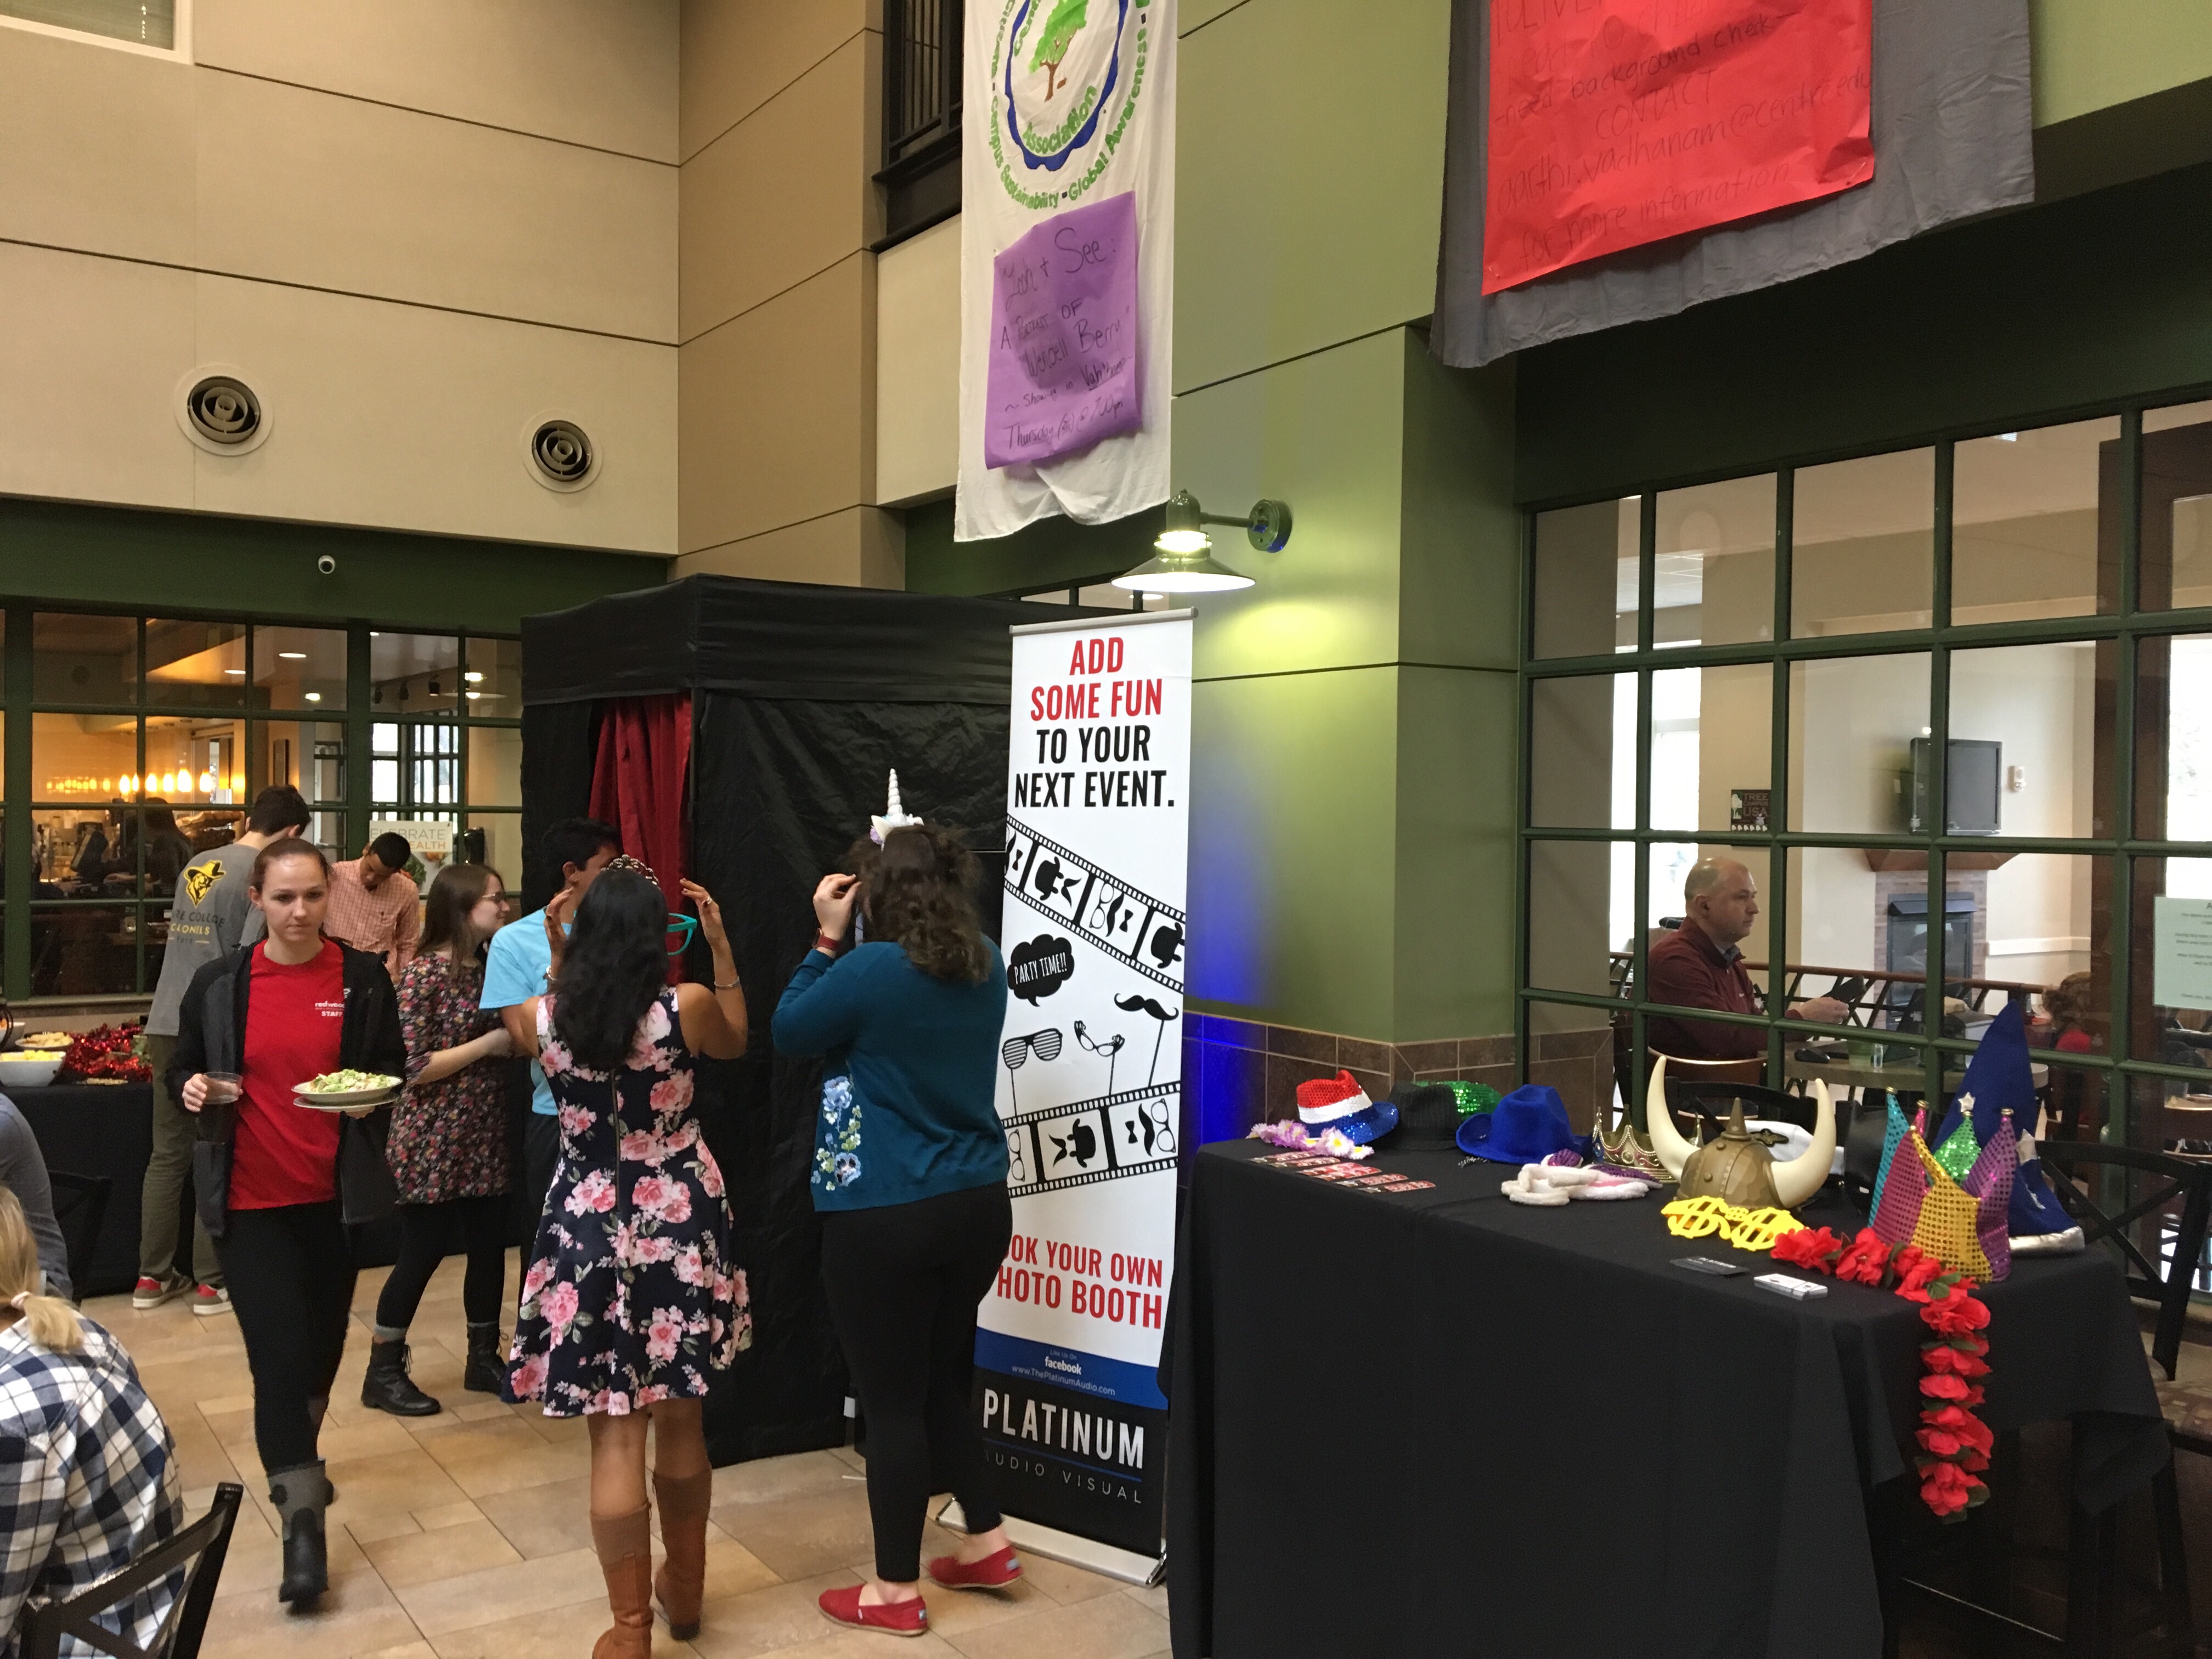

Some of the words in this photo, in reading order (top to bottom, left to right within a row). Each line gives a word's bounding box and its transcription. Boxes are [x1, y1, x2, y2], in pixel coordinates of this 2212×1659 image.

[1571, 32, 1701, 100] background
[1000, 164, 1059, 210] Sustainability
[1069, 151, 1109, 201] Global
[1105, 27, 1147, 156] Awareness
[1022, 86, 1097, 154] Association
[1595, 68, 1717, 140] CONTACT
[1520, 225, 1561, 272] for
[1568, 204, 1628, 248] more
[1641, 161, 1790, 221] information
[1054, 227, 1116, 274] See:
[1000, 325, 1012, 350] A
[1061, 297, 1083, 319] OF
[1024, 334, 1068, 377] Wendell
[1065, 381, 1074, 390] in
[1003, 422, 1054, 449] Thursday
[1069, 636, 1124, 676] ADD
[1030, 682, 1102, 721] SOME
[1111, 678, 1163, 718] FUN
[1036, 728, 1068, 764] TO
[1079, 725, 1151, 763] YOUR
[1014, 772, 1075, 808] NEXT
[1084, 770, 1175, 808] EVENT.
[1743, 793, 1769, 801] TREE
[1743, 807, 1769, 817] USA
[370, 828, 446, 840] EBRATE
[188, 911, 226, 928] COLLGE
[1014, 961, 1039, 985] PARTY
[1039, 951, 1068, 978] TIME!!
[1007, 1234, 1039, 1266] OK
[1046, 1240, 1102, 1278] YOUR
[1110, 1253, 1163, 1289] OWN
[1071, 1279, 1163, 1330] BOOTH
[1011, 1365, 1116, 1396] www.ThePlatinumAudio.com
[1045, 1356, 1082, 1376] facebook
[982, 1387, 1145, 1470] PLATINUM
[1062, 1470, 1142, 1504] VISUAL
